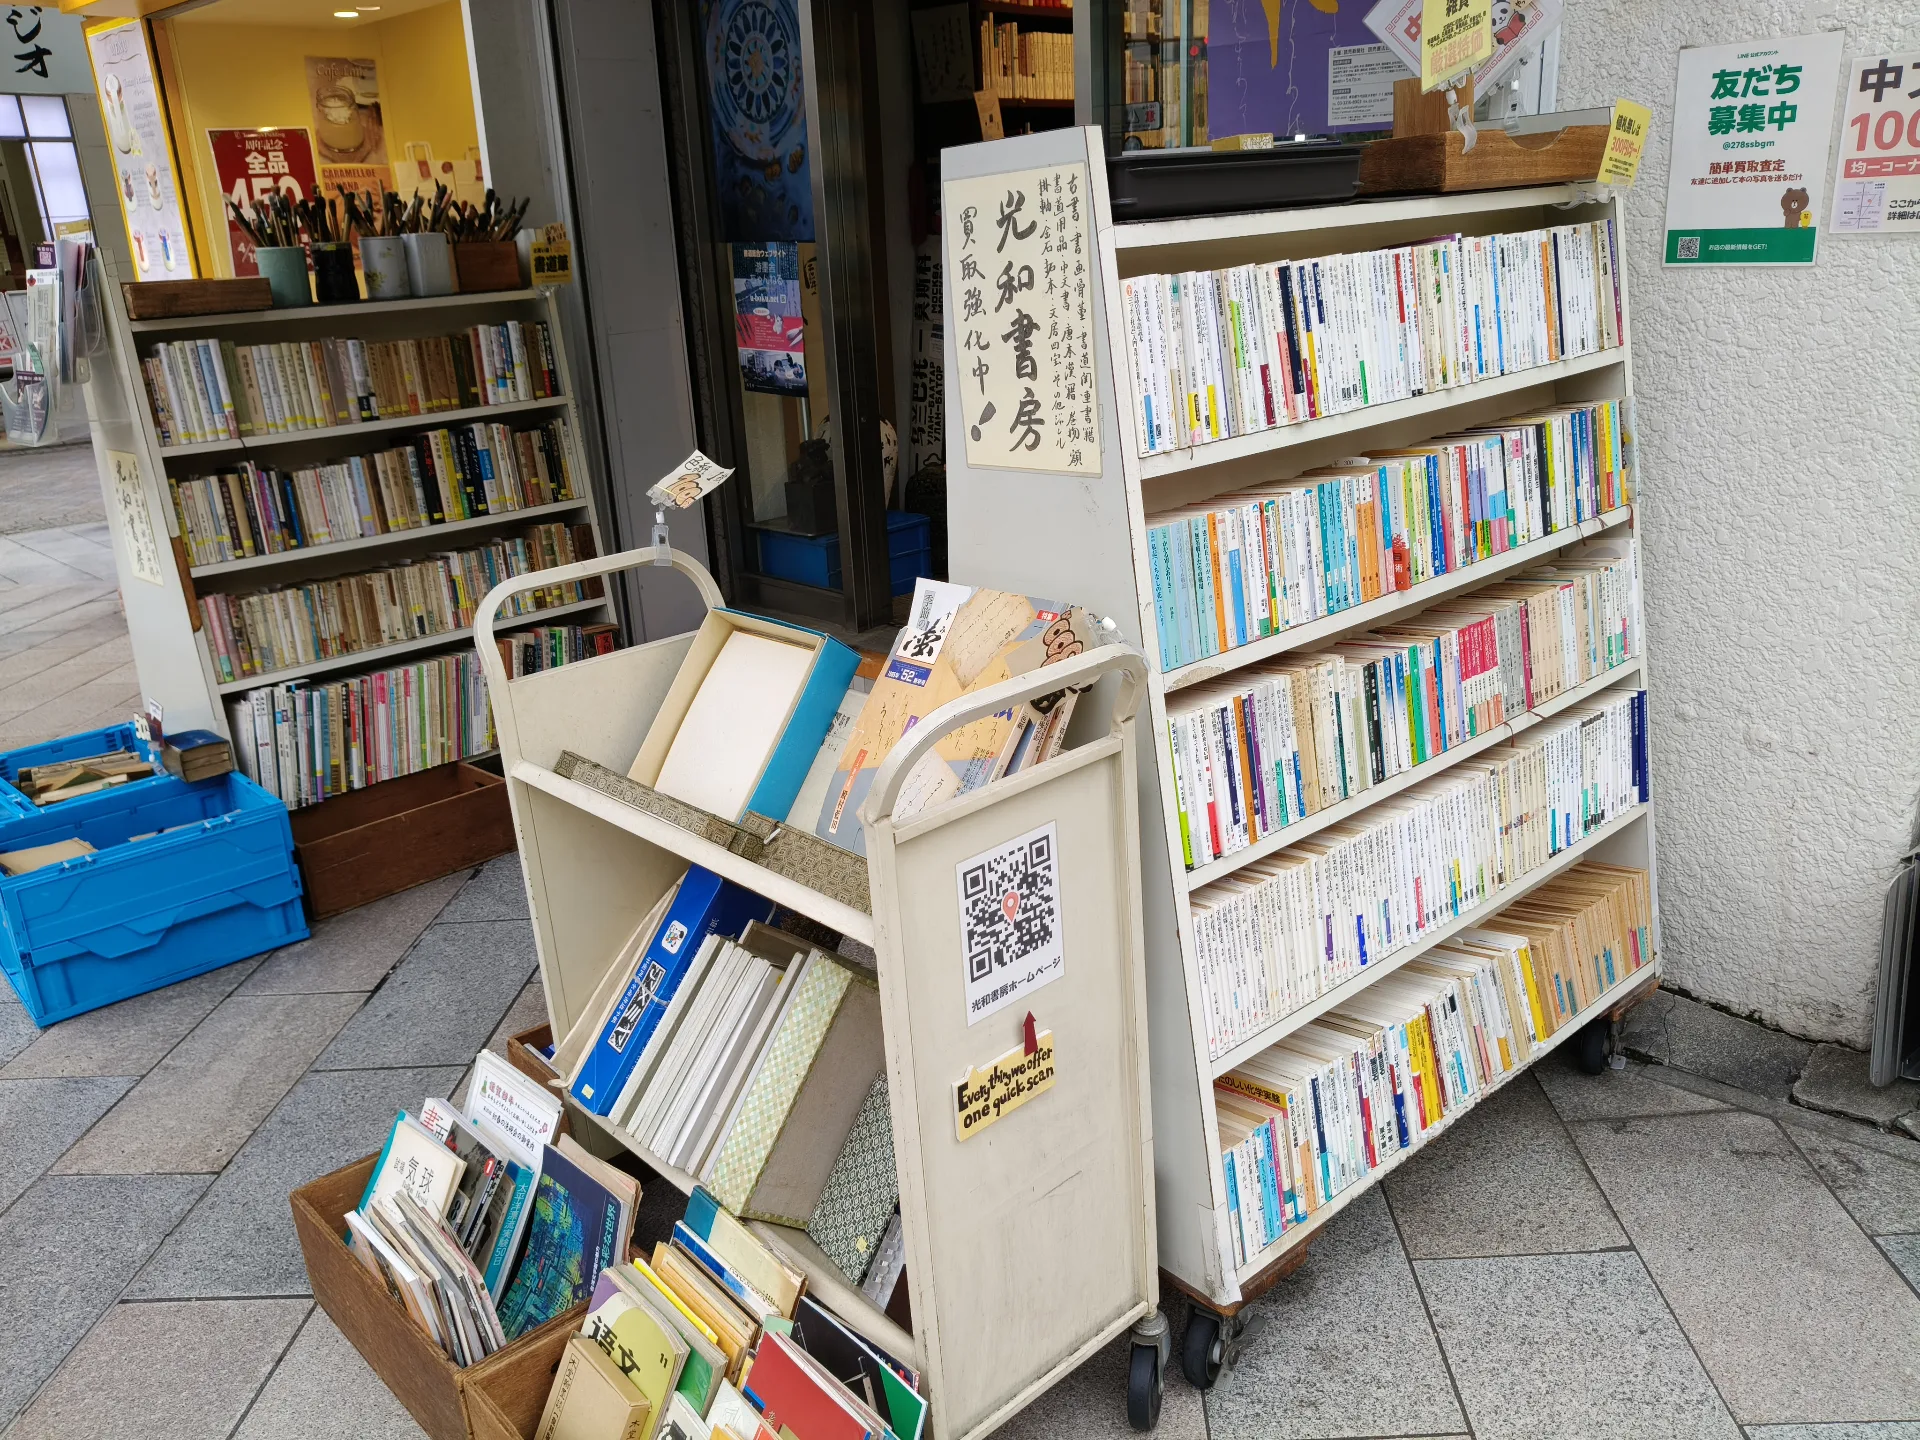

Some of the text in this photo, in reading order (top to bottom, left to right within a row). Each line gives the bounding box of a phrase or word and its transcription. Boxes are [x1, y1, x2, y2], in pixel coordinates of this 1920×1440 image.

[1710, 64, 1803, 100] 友だち
[1708, 101, 1798, 136] 募集中
[1722, 140, 1775, 150] @278ssbgm
[244, 152, 290, 175] 全品
[1709, 159, 1786, 175] 簡単買取査定
[995, 189, 1045, 452] 光和書房
[971, 956, 1061, 1013] 光和書房ホームページ
[957, 1047, 1053, 1112] Everything we offer
[963, 1066, 1055, 1129] one quick scan
